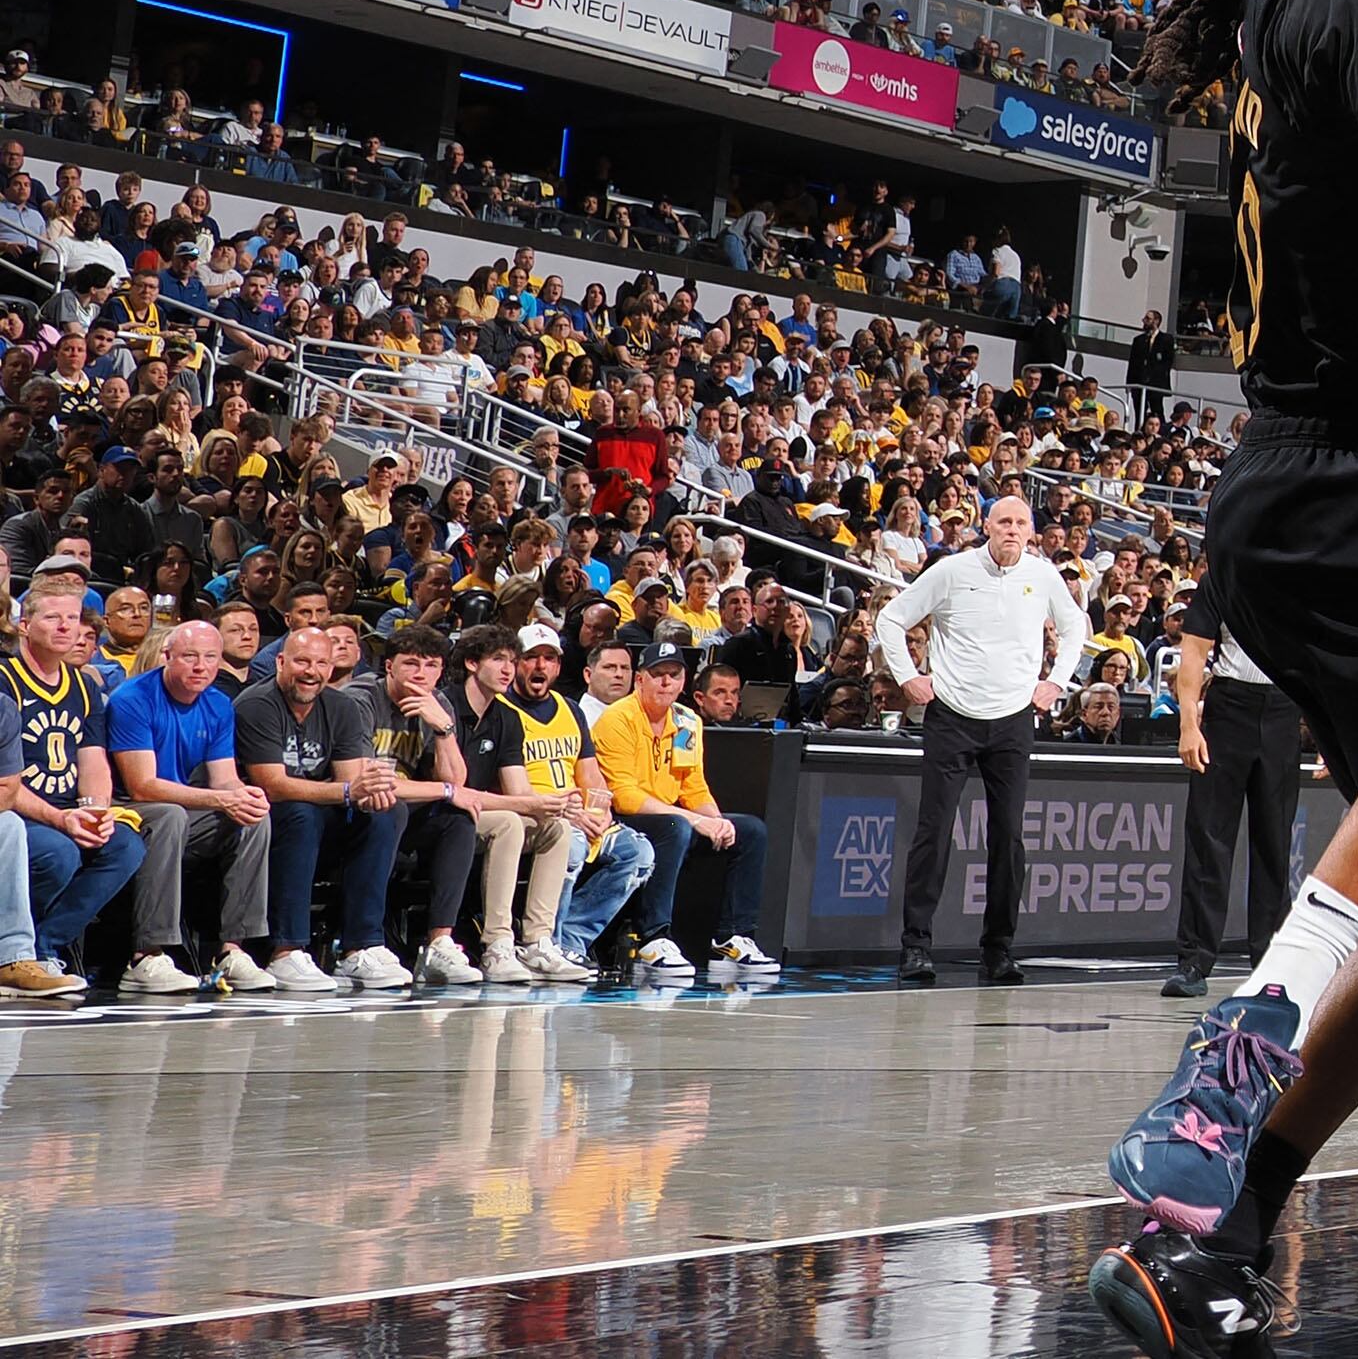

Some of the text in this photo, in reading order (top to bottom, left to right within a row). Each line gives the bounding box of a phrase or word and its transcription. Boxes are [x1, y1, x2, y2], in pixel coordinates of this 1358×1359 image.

[626, 8, 730, 52] DEVAULT
[887, 77, 918, 102] mhs
[1040, 111, 1149, 165] salesforce
[22, 710, 83, 744] INDIANA
[47, 732, 67, 772] 0
[550, 758, 565, 789] 0
[962, 863, 1173, 915] EPRESS
